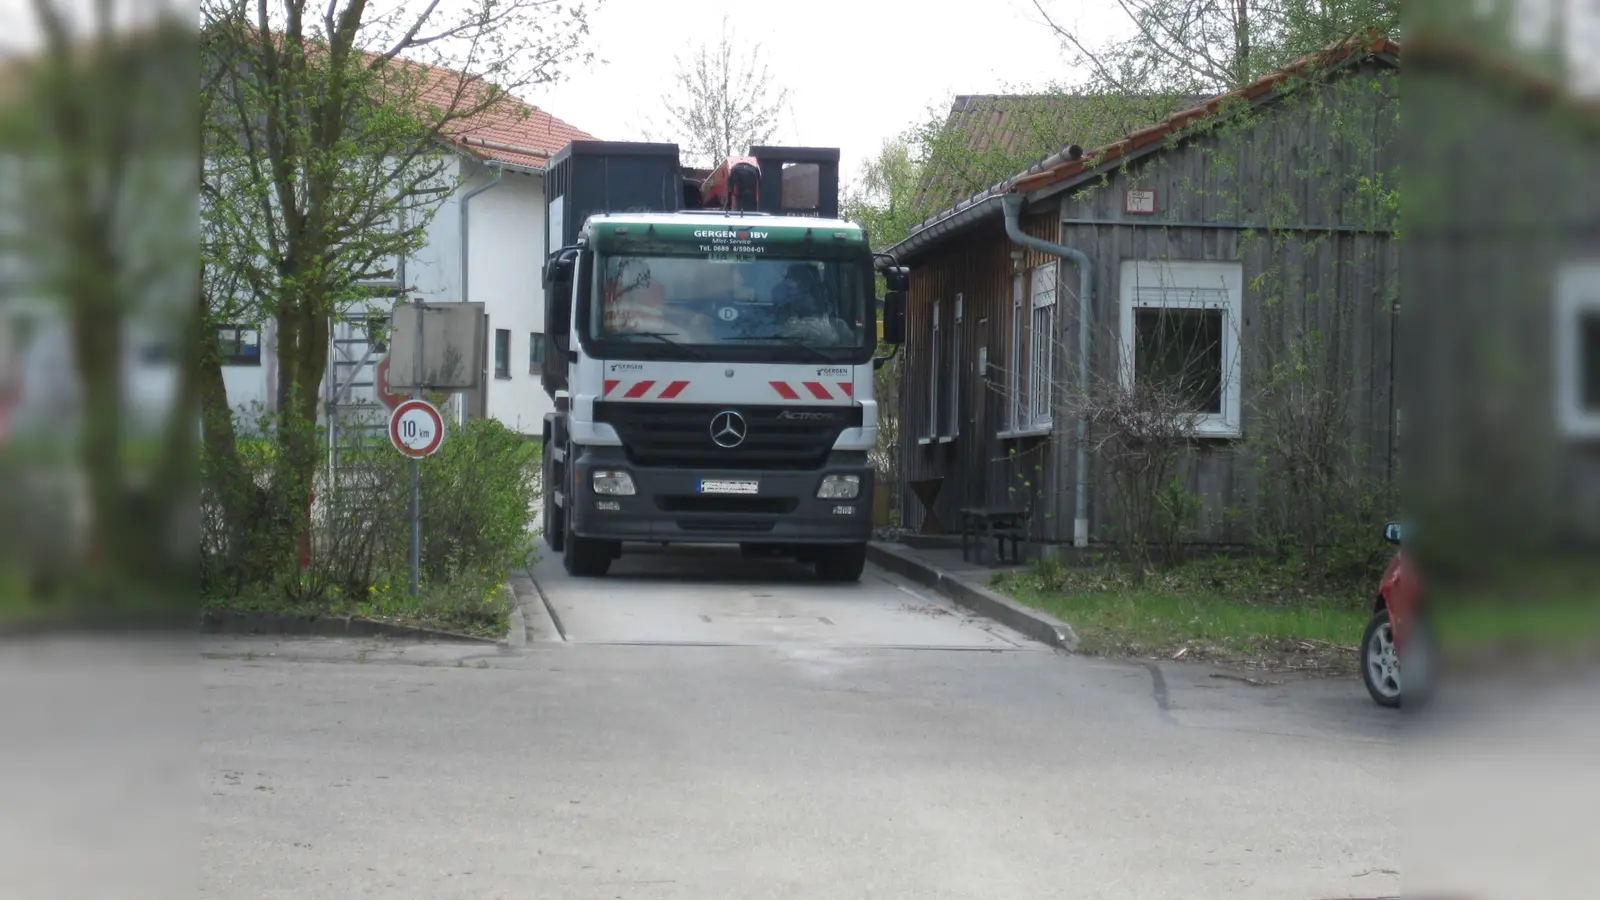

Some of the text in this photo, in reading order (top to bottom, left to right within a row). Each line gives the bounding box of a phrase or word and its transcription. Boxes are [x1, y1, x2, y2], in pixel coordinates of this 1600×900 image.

[694, 230, 768, 239] GERGEN IBV
[402, 420, 430, 438] 10 km
